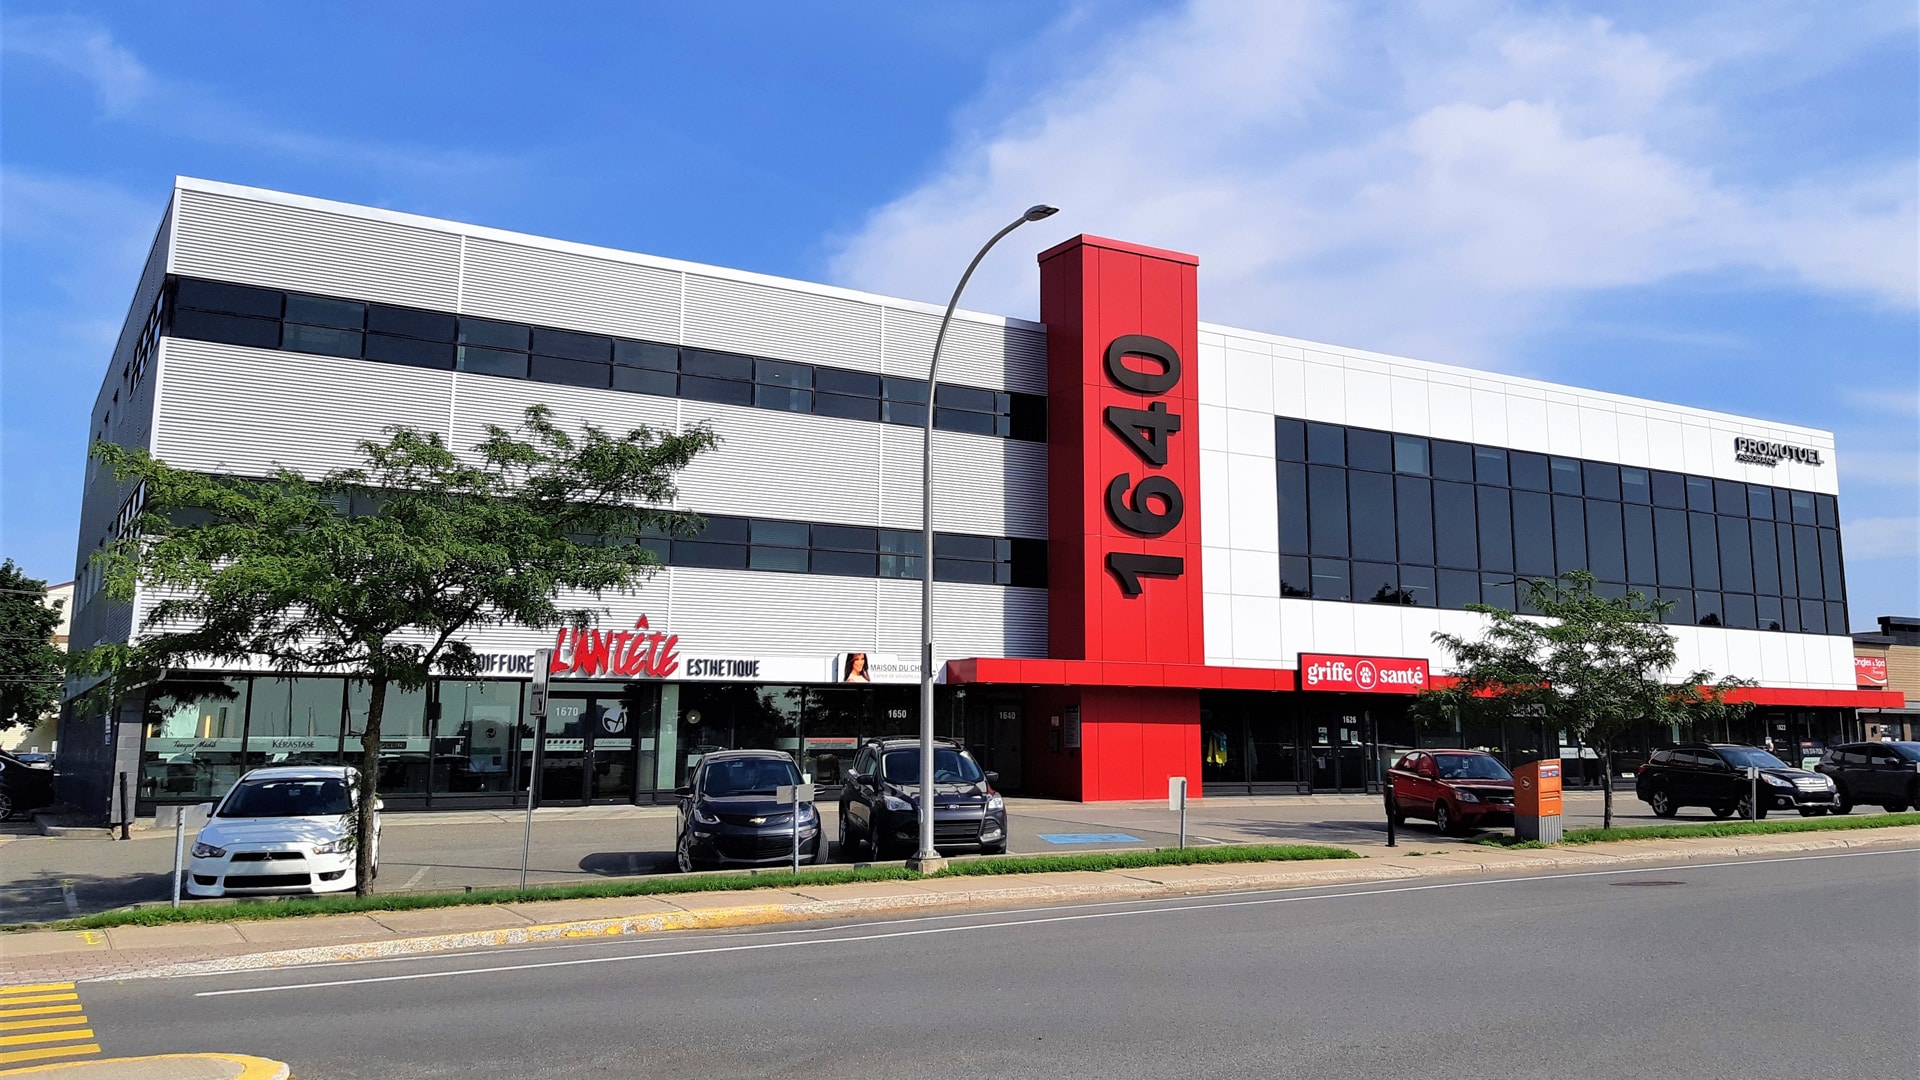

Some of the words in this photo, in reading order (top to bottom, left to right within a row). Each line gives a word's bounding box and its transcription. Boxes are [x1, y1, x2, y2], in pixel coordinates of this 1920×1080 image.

[1734, 437, 1824, 466] PROMUTUEL
[1103, 334, 1184, 599] 1640
[474, 653, 535, 673] OIFFURE
[686, 658, 760, 678] ESTHETIQUE
[870, 664, 897, 672] MAISON
[899, 664, 909, 672] DU
[1307, 661, 1352, 685] griffe
[1380, 666, 1423, 684] santé
[556, 707, 579, 717] 1670
[887, 709, 907, 719] 1650
[999, 711, 1016, 720] 1640
